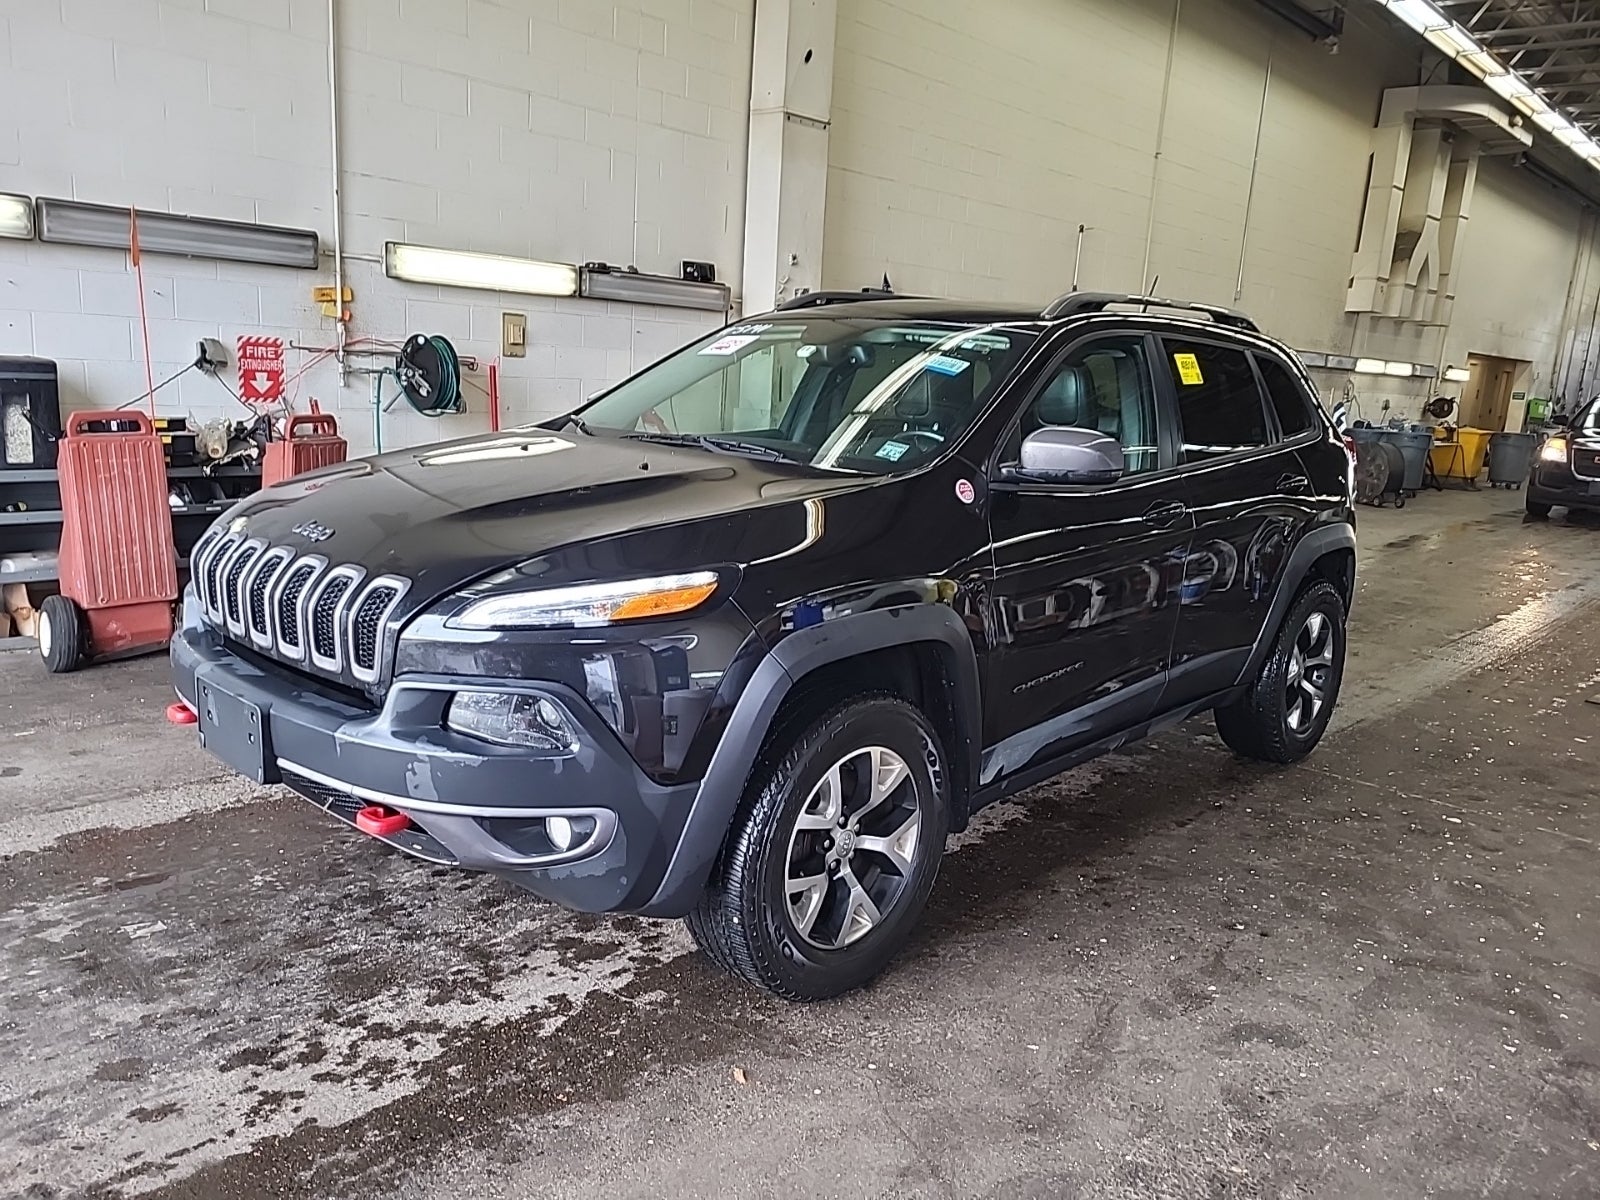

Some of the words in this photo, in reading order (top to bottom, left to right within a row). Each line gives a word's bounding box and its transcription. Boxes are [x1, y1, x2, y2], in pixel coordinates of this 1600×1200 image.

[246, 345, 276, 358] FIRE
[241, 359, 282, 371] EXTINGUISHER
[291, 519, 336, 543] Jeep
